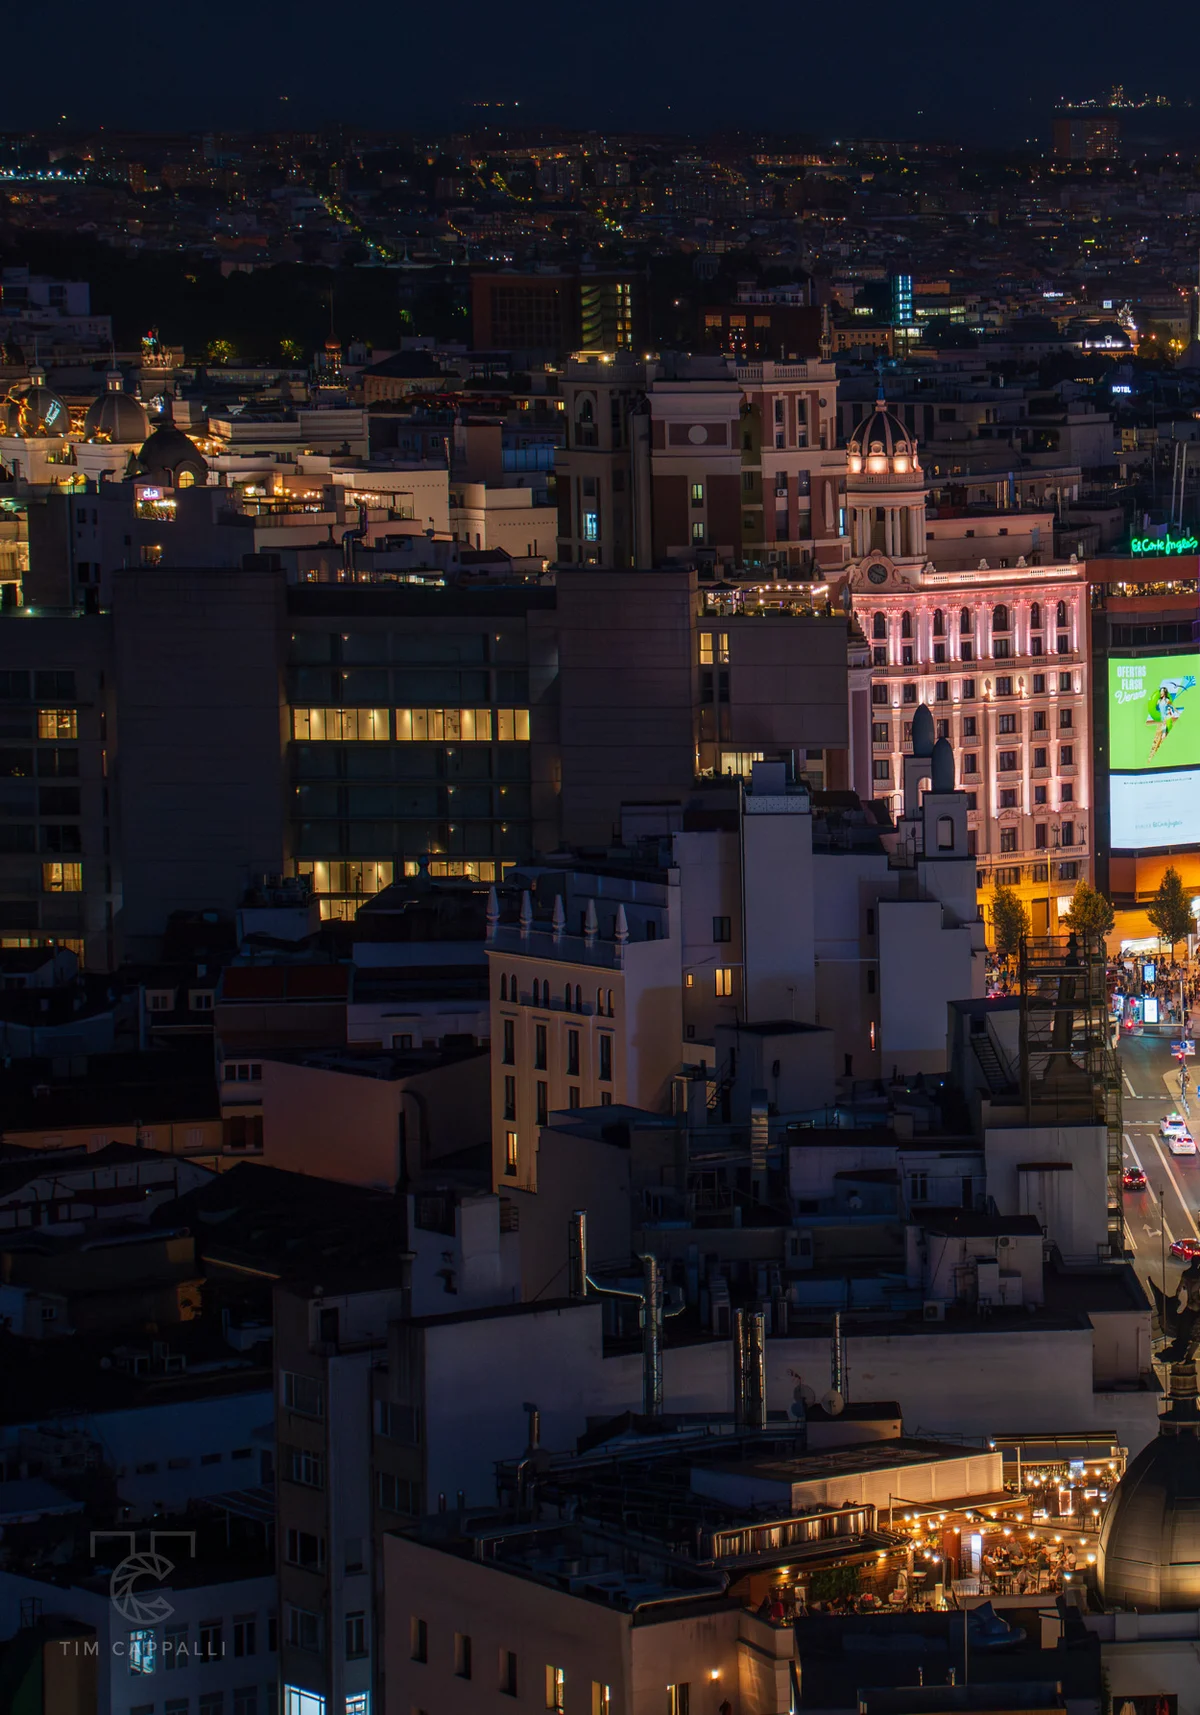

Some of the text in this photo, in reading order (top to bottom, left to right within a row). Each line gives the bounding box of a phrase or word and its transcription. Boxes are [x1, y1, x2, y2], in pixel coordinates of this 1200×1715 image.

[1131, 538, 1141, 552] El
[1142, 538, 1164, 552] Corte
[1117, 665, 1147, 678] OFERTAS
